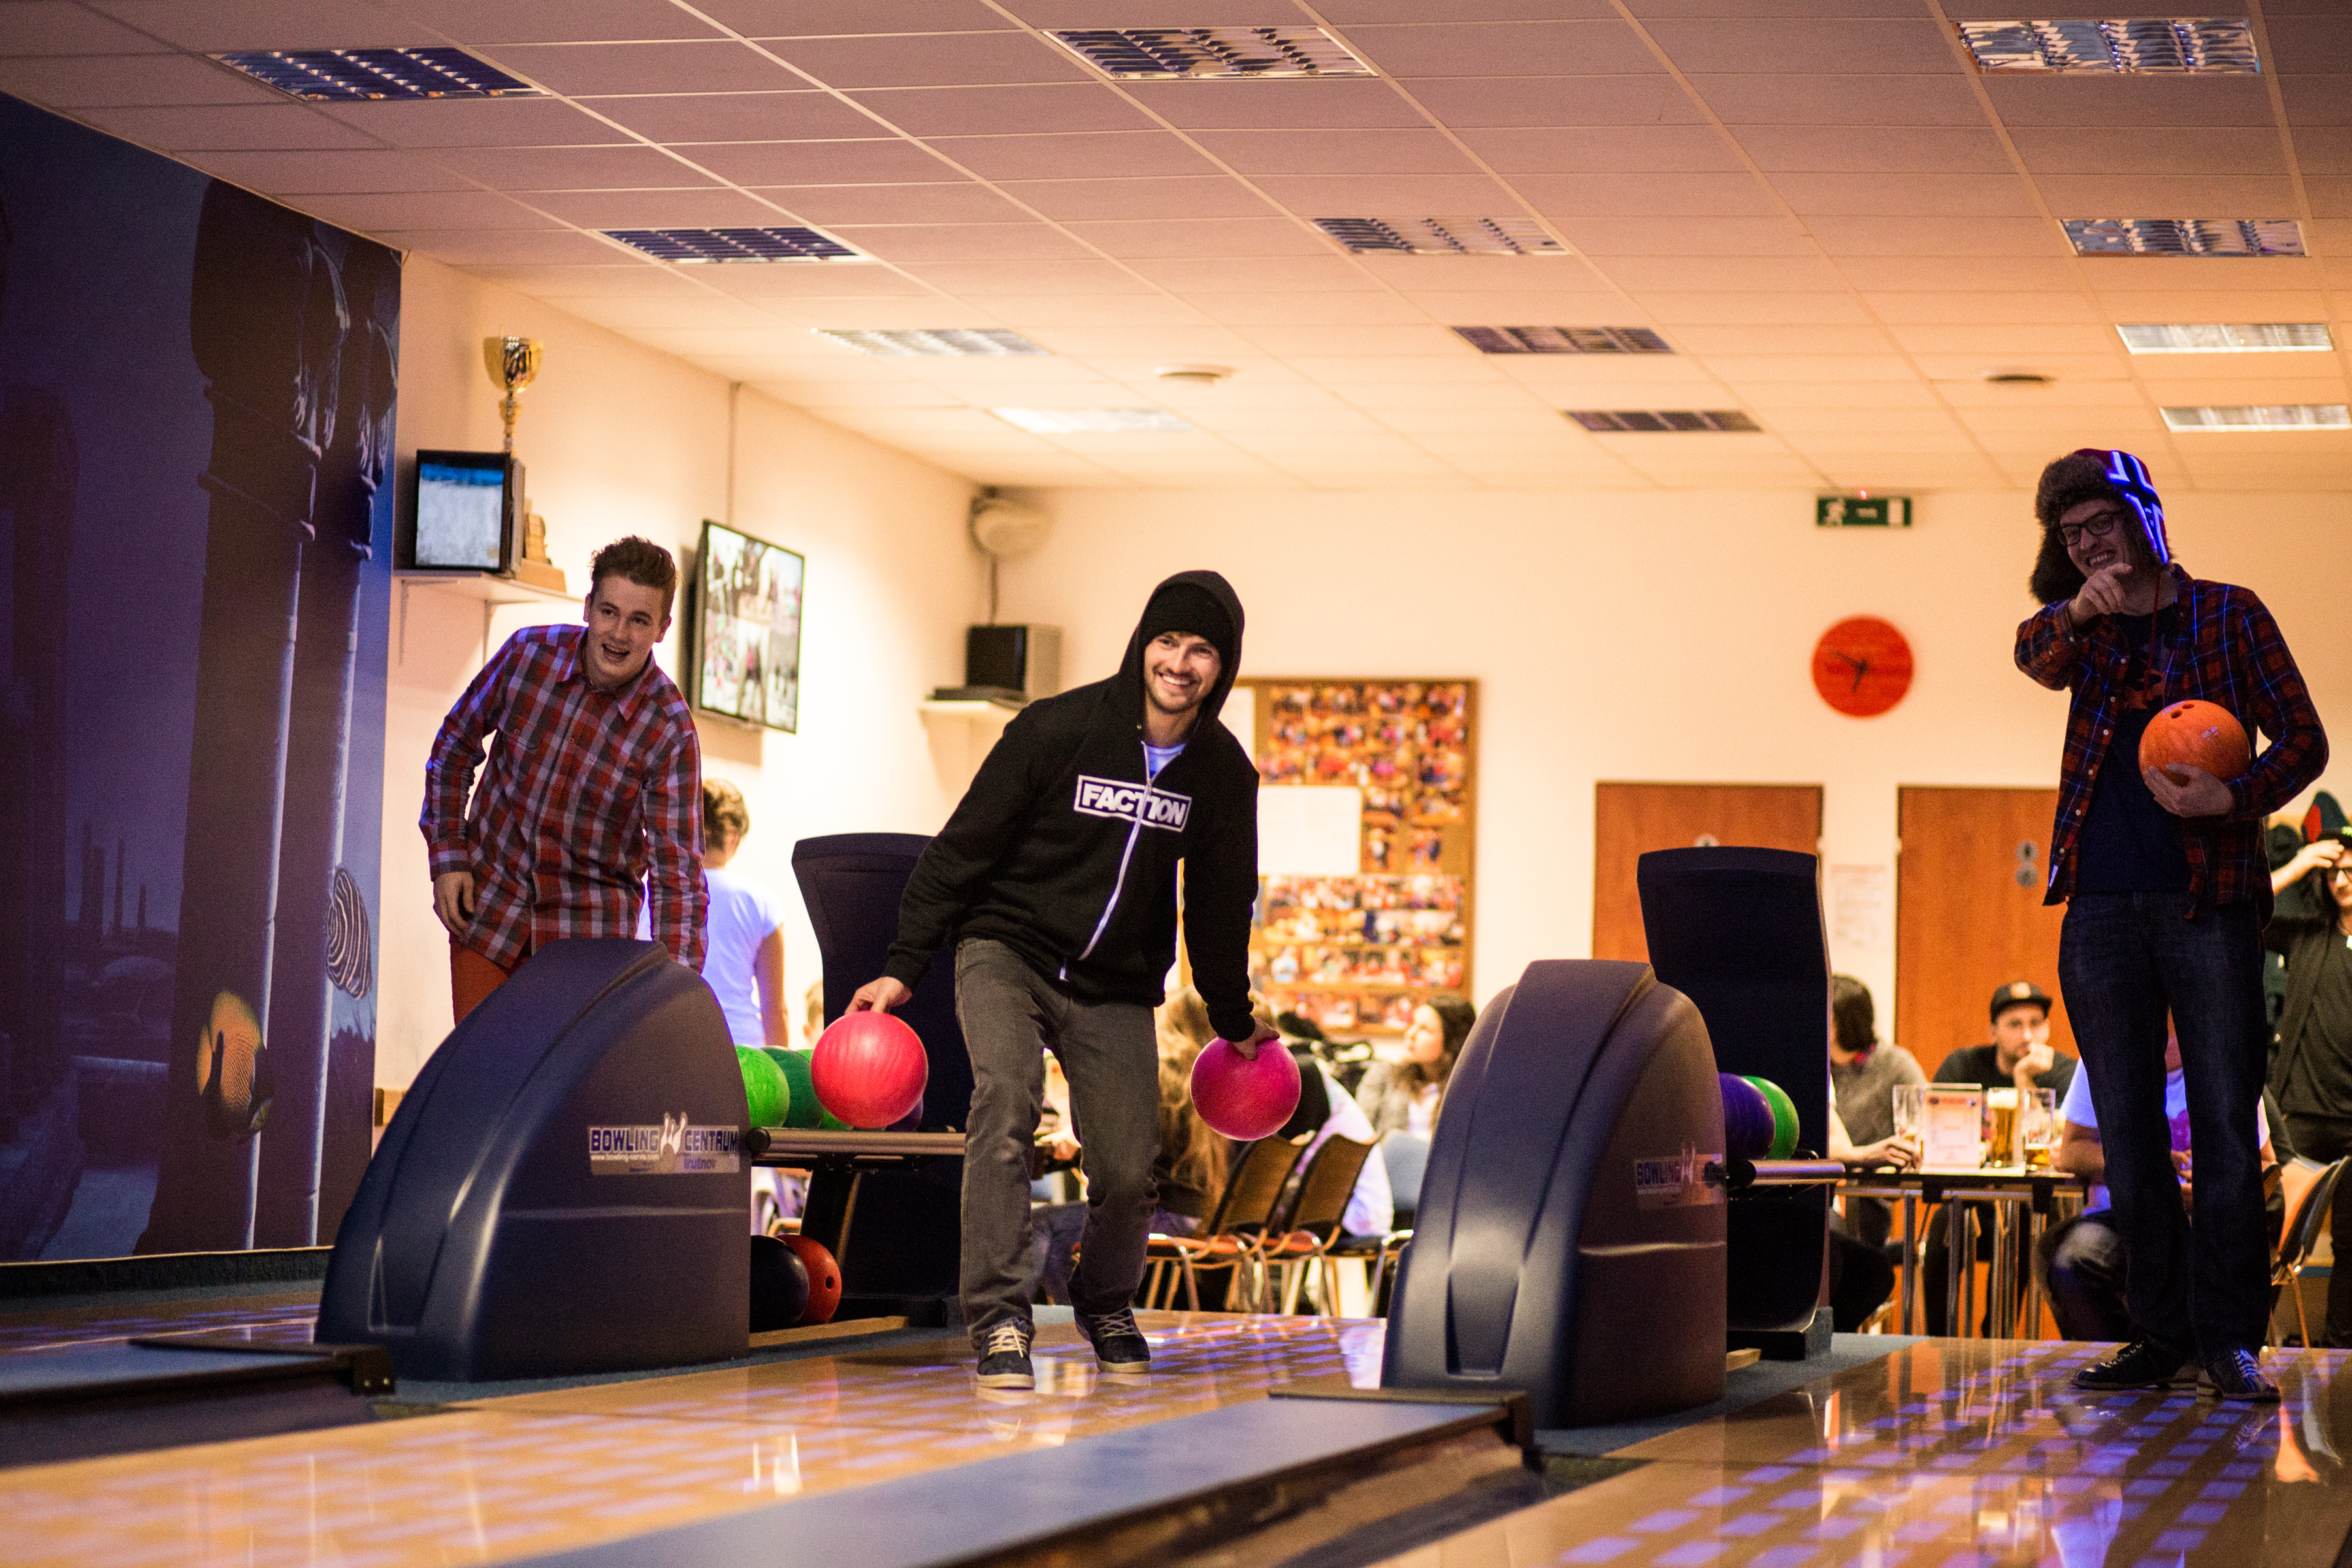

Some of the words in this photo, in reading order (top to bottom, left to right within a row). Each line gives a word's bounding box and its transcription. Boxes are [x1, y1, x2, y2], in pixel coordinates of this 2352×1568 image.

[1081, 783, 1186, 825] FACTION
[590, 1128, 660, 1152] BOWLING
[685, 1129, 739, 1152] CENTRUM
